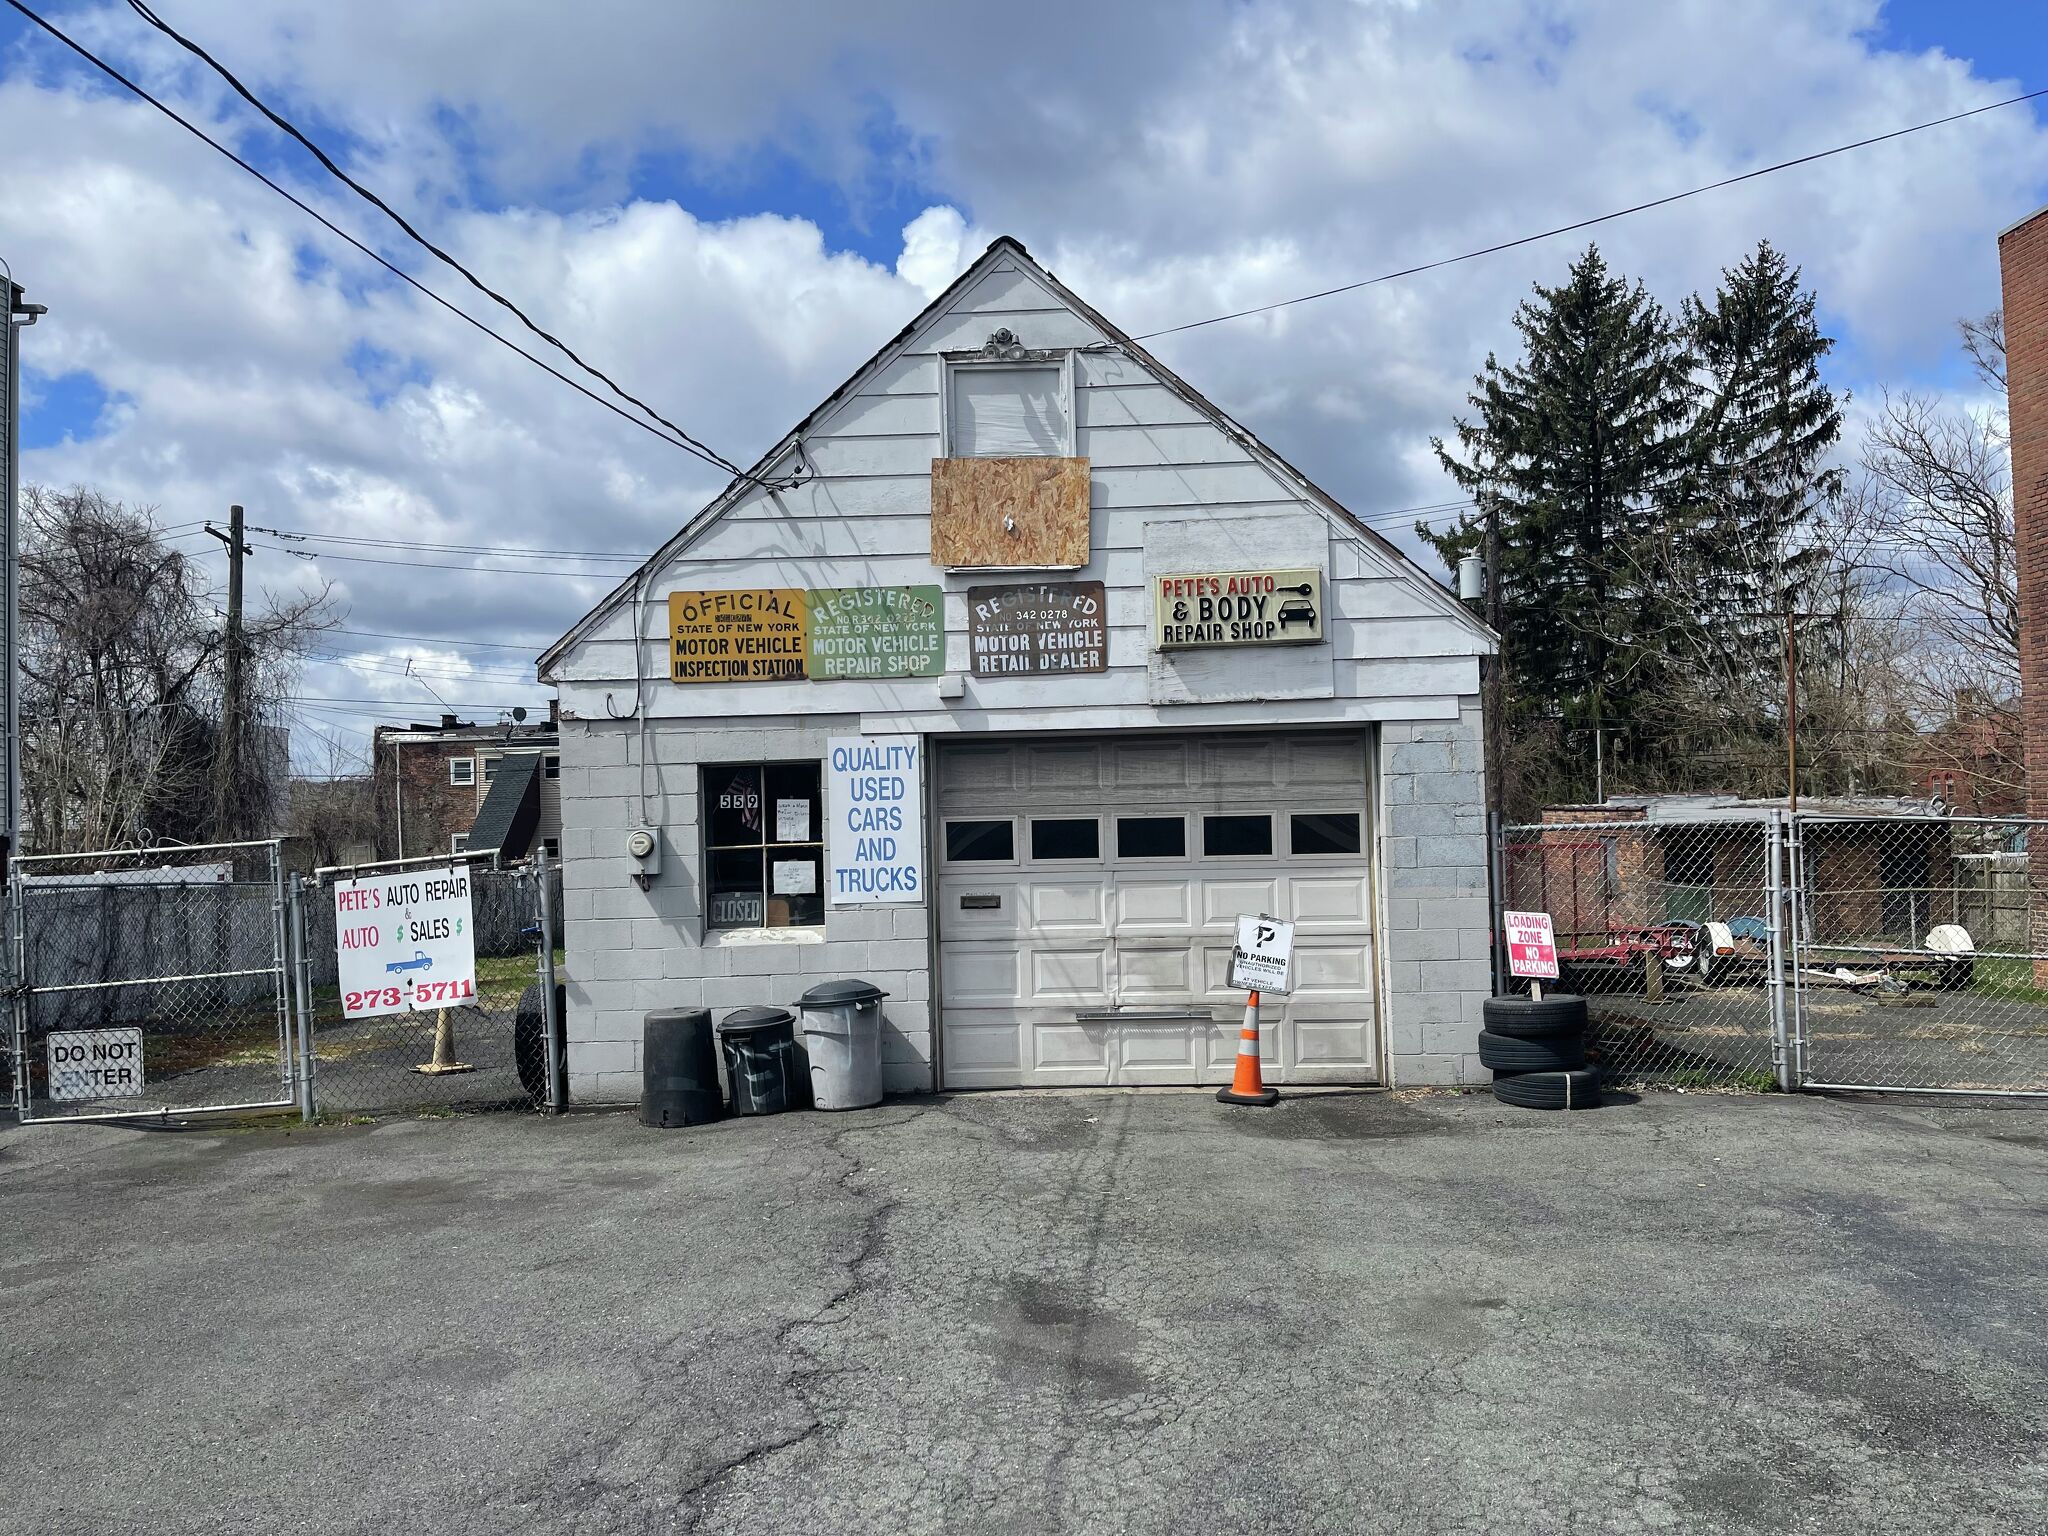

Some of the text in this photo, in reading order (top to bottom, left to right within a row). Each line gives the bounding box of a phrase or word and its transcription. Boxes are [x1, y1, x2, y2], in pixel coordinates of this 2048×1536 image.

[1162, 575, 1275, 598] PETE'S AUTO
[683, 593, 796, 621] OFFICIAL
[813, 588, 935, 624] REGISTERED
[1016, 610, 1037, 620] 342
[1040, 609, 1068, 619] 0278
[1172, 595, 1267, 621] & BODY
[677, 622, 800, 634] STATE OF NEW YORK
[814, 621, 937, 635] STATE OF NEW YORK
[1036, 620, 1061, 631] NEW
[1068, 618, 1099, 629] YORK
[1163, 620, 1275, 643] REPAIR SHOP
[676, 637, 802, 655] MOTOR VEHICLE
[813, 634, 939, 656] MOTOR VEHICLE
[974, 629, 1103, 653] MOTOR VEHICLE
[674, 658, 804, 678] INSPECTION STATION
[825, 654, 931, 675] REPAIR SHOP
[979, 650, 1100, 673] RETAIL DEALER
[832, 746, 917, 772] QUALITY
[850, 776, 905, 802] USED
[720, 795, 758, 808] 559
[848, 806, 902, 832] CARS
[855, 837, 897, 862] AND
[835, 866, 918, 893] TRUCKS
[338, 876, 468, 912] PETE'S AUTO REPAIR
[404, 908, 412, 920] &
[712, 899, 761, 924] CLOSED
[1508, 915, 1548, 930] LOADING
[341, 925, 380, 950] AUTO
[410, 917, 450, 942] SALES
[1517, 930, 1543, 944] ZONE
[1236, 950, 1287, 967] NO PARKING
[1525, 946, 1540, 960] NO
[1511, 959, 1555, 975] PARKING
[344, 978, 475, 1011] 273-5711
[54, 1042, 137, 1063] DO NOT
